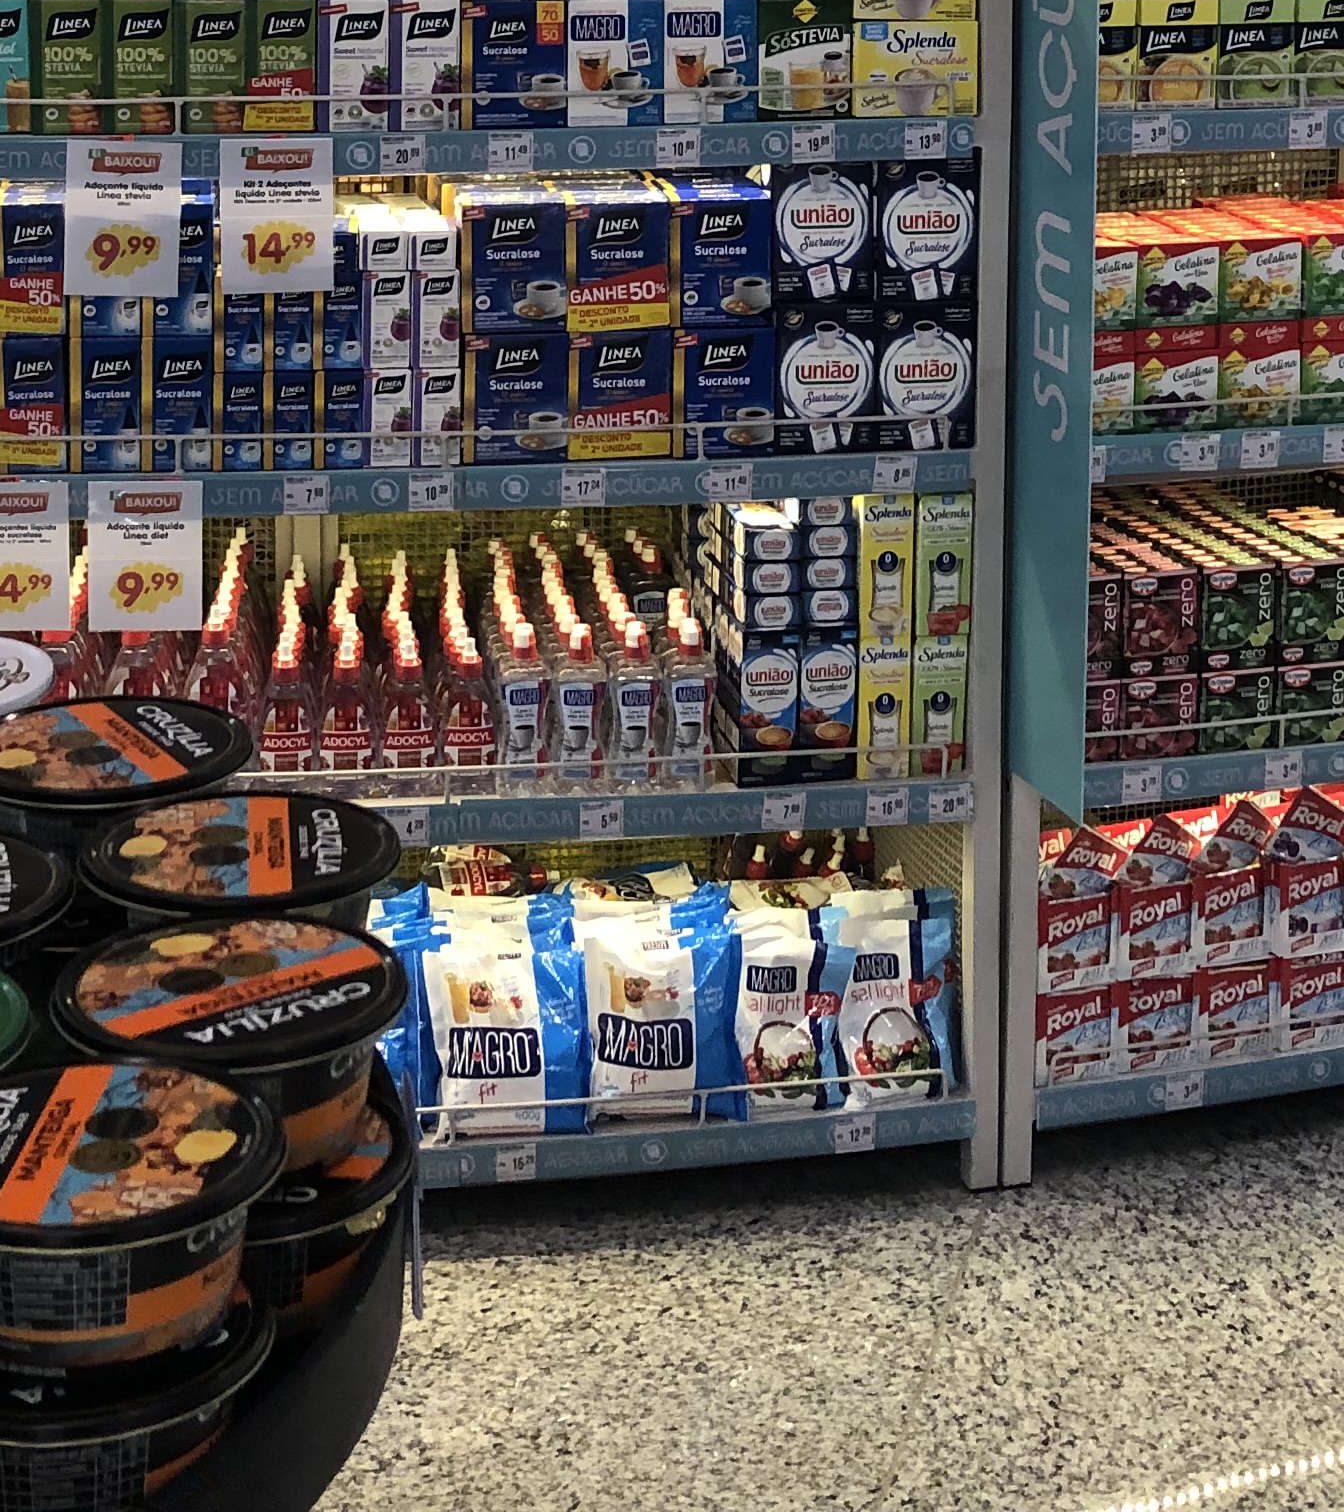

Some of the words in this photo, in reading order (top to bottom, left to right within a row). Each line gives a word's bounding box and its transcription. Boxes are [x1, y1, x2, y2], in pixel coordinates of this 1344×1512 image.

[492, 215, 536, 239] LINEA
[796, 206, 848, 224] união
[901, 212, 955, 229] união
[92, 233, 156, 271] 9,99
[243, 231, 315, 264] 14,99
[486, 248, 541, 262] Sucralose
[569, 286, 628, 304] GANHE
[1027, 204, 1072, 441] SEM
[865, 505, 912, 522] Splenda
[117, 572, 179, 607] 9,99
[1180, 577, 1194, 627] zero
[746, 666, 792, 685] união
[263, 735, 309, 749] ADOCYL
[1047, 909, 1107, 938] Royal
[750, 969, 794, 990] MAGRO
[449, 1032, 538, 1076] MAGRO
[602, 1018, 688, 1066] MAGRO
